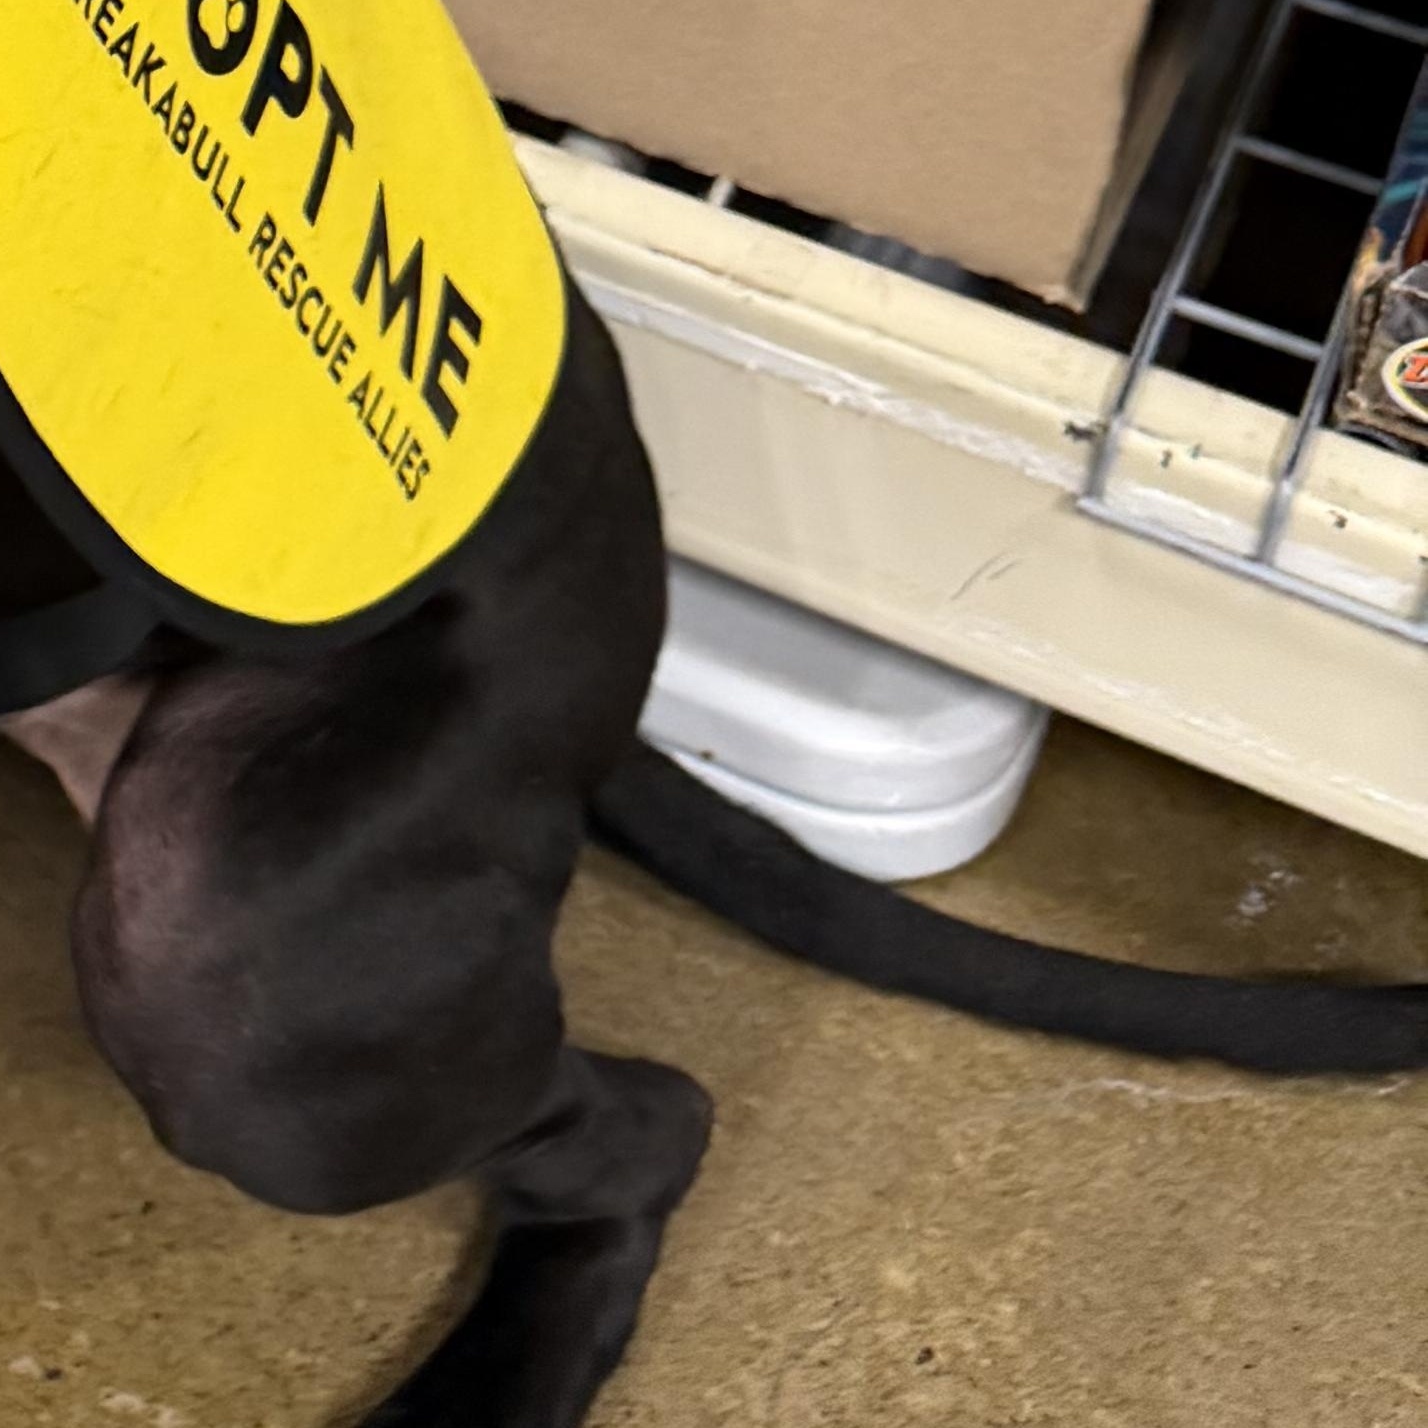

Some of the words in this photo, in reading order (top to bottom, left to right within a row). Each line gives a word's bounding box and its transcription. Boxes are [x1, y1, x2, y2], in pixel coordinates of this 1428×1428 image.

[247, 219, 359, 386] RESCUE
[347, 368, 435, 504] ALLIES
[351, 179, 482, 439] ME
